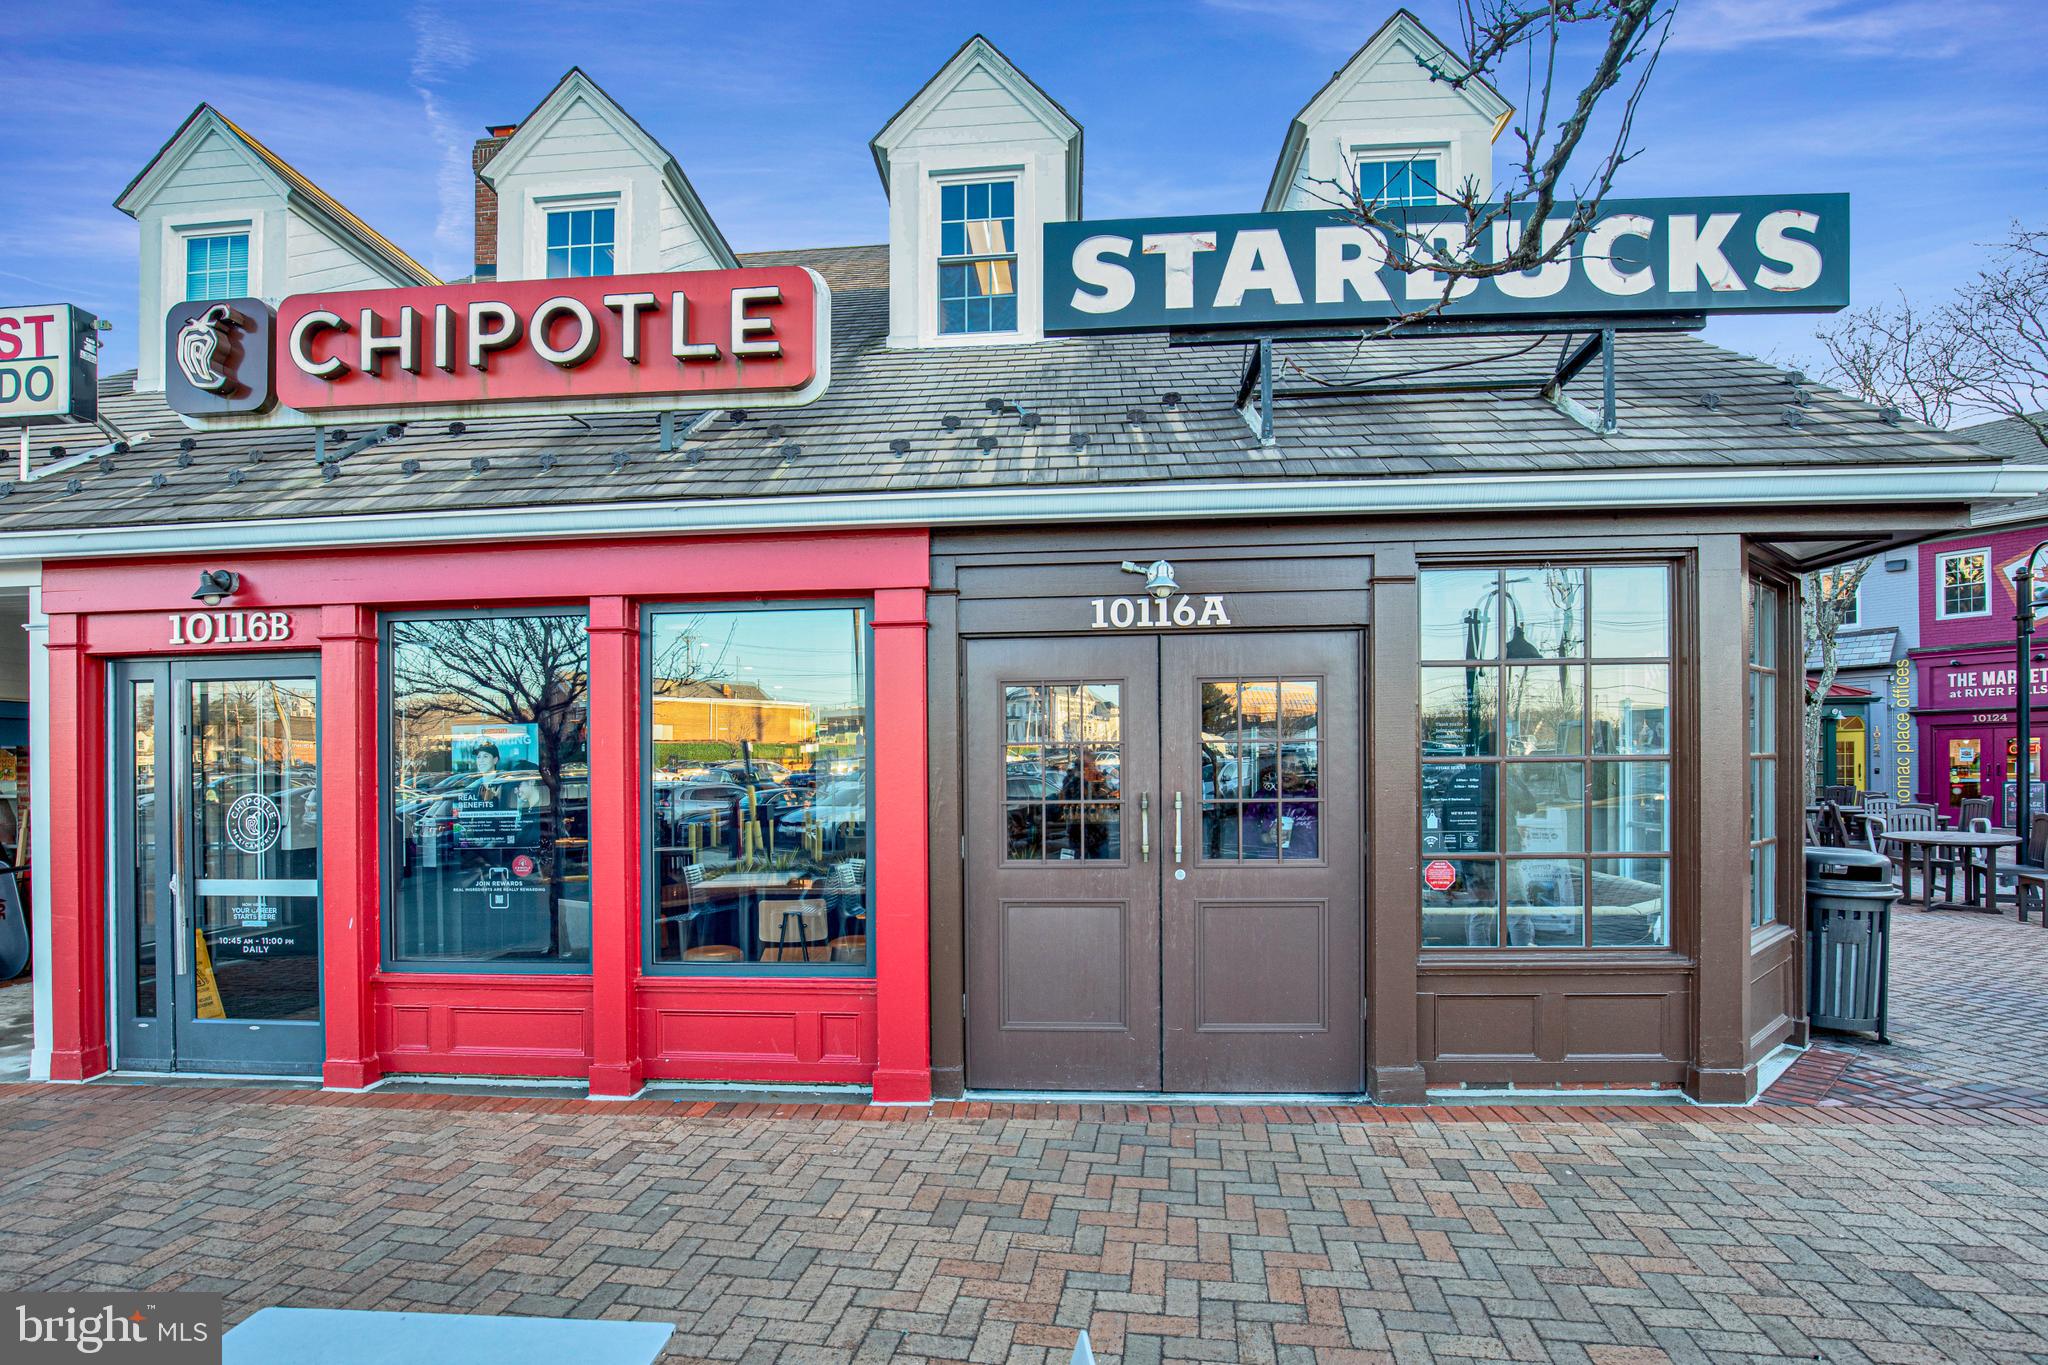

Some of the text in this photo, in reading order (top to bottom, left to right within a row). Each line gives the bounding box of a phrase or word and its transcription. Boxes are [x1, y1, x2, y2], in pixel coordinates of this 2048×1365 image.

[1070, 209, 1824, 315] STARBUCKS
[0, 314, 55, 361] ST
[288, 285, 785, 380] CHIPOTLE
[1091, 594, 1231, 629] 10116A
[168, 611, 291, 645] 10116B
[1892, 659, 1910, 708] offices
[1947, 667, 2048, 688] THE MARET
[1949, 689, 1962, 698] at
[1965, 687, 2005, 698] RIVER
[1972, 713, 2008, 723] 10124
[1894, 712, 1915, 753] place
[231, 797, 277, 819] CHIPOTLE
[458, 801, 494, 809] BENEFITS
[232, 828, 276, 848] MEXICAN GRILL
[219, 937, 242, 945] 10:45
[261, 937, 283, 945] 11:00
[242, 945, 270, 954] DAILY
